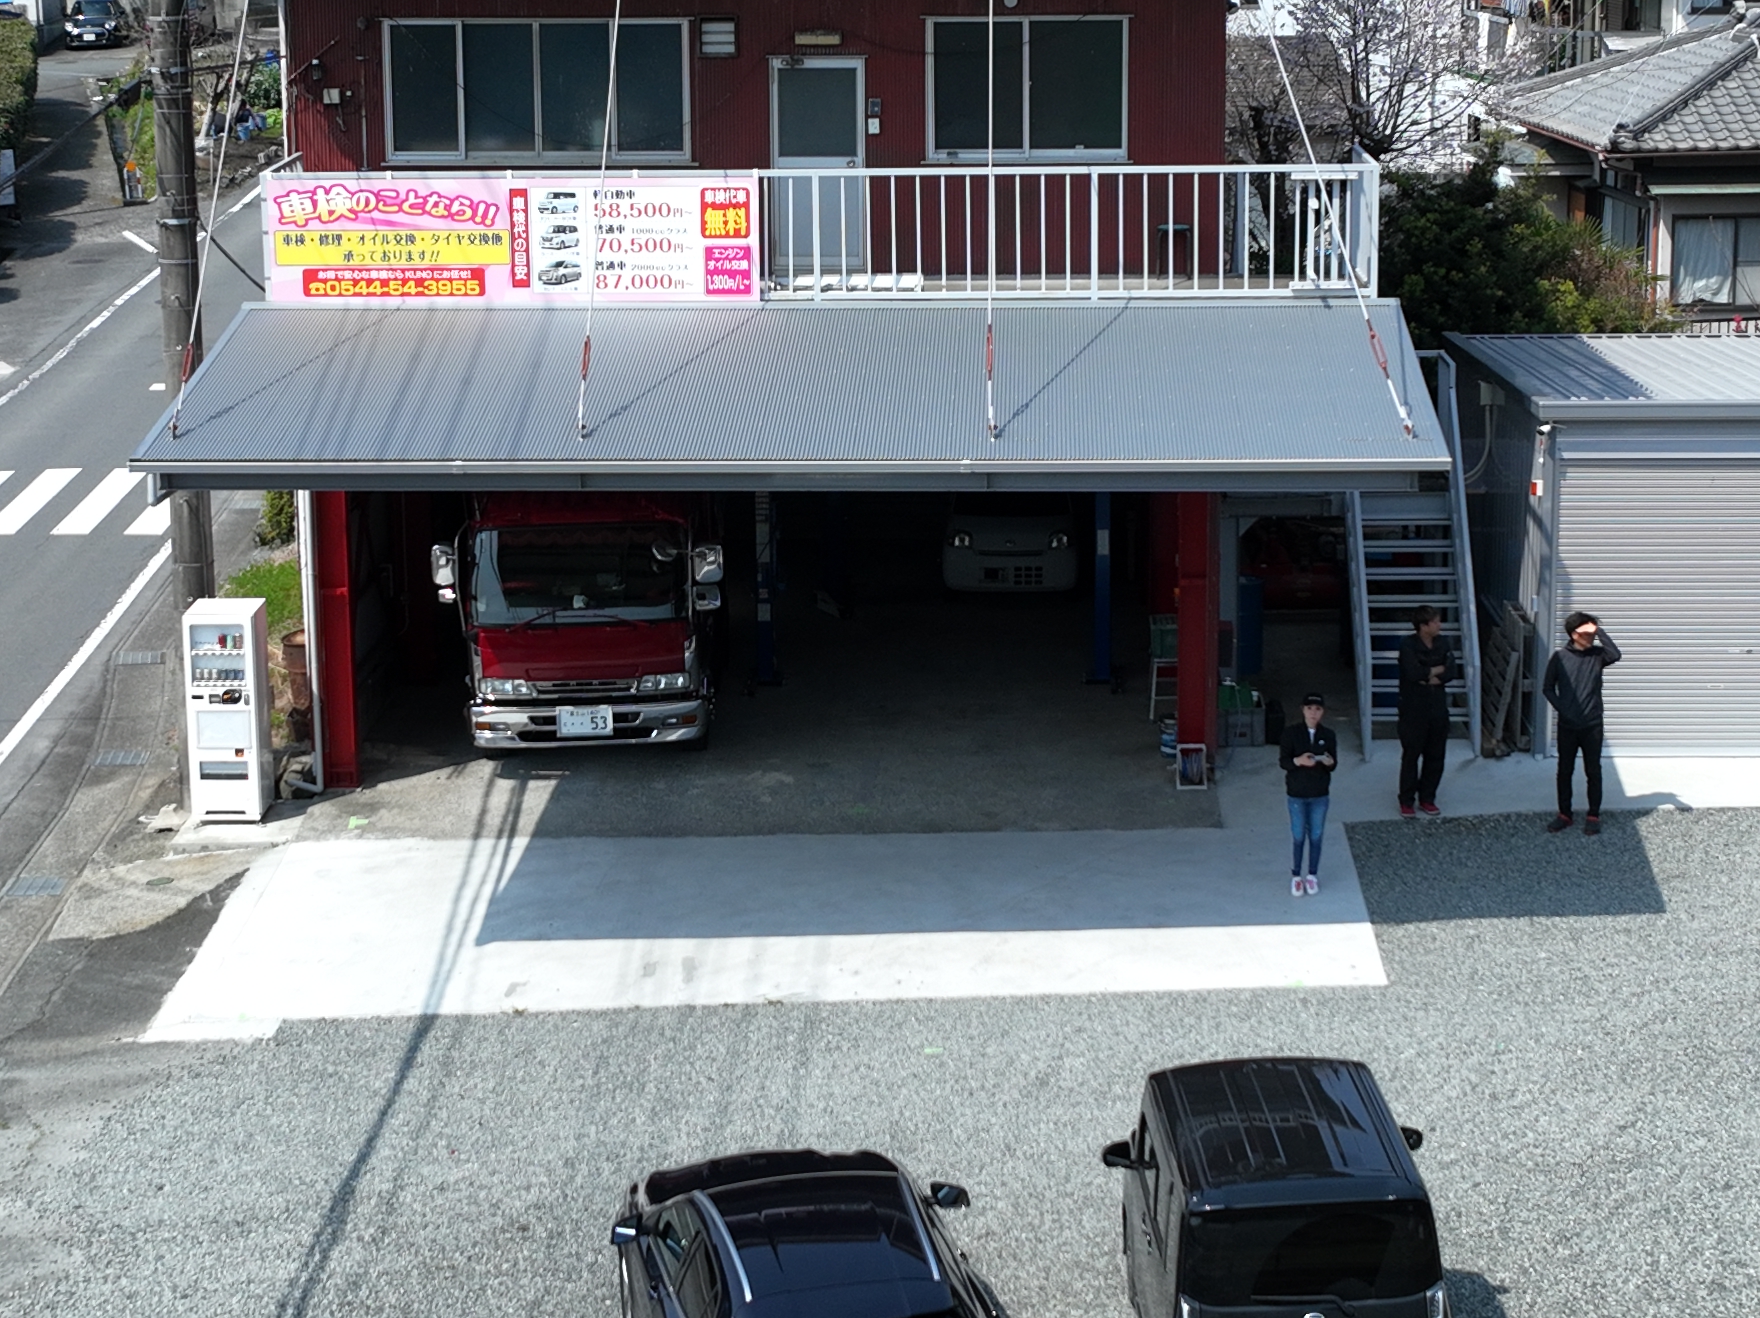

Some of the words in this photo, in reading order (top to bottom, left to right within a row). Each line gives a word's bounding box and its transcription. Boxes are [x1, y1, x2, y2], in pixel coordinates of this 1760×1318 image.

[275, 184, 499, 227] 車検のことなら!!
[704, 207, 747, 236] 無料
[512, 195, 528, 280] 車検代の目安
[343, 250, 440, 263] 承っております!!
[712, 248, 744, 258] エンジン
[595, 261, 626, 271] 普通車
[707, 259, 748, 270] オイル交換
[326, 280, 480, 296] 0544-54-3955
